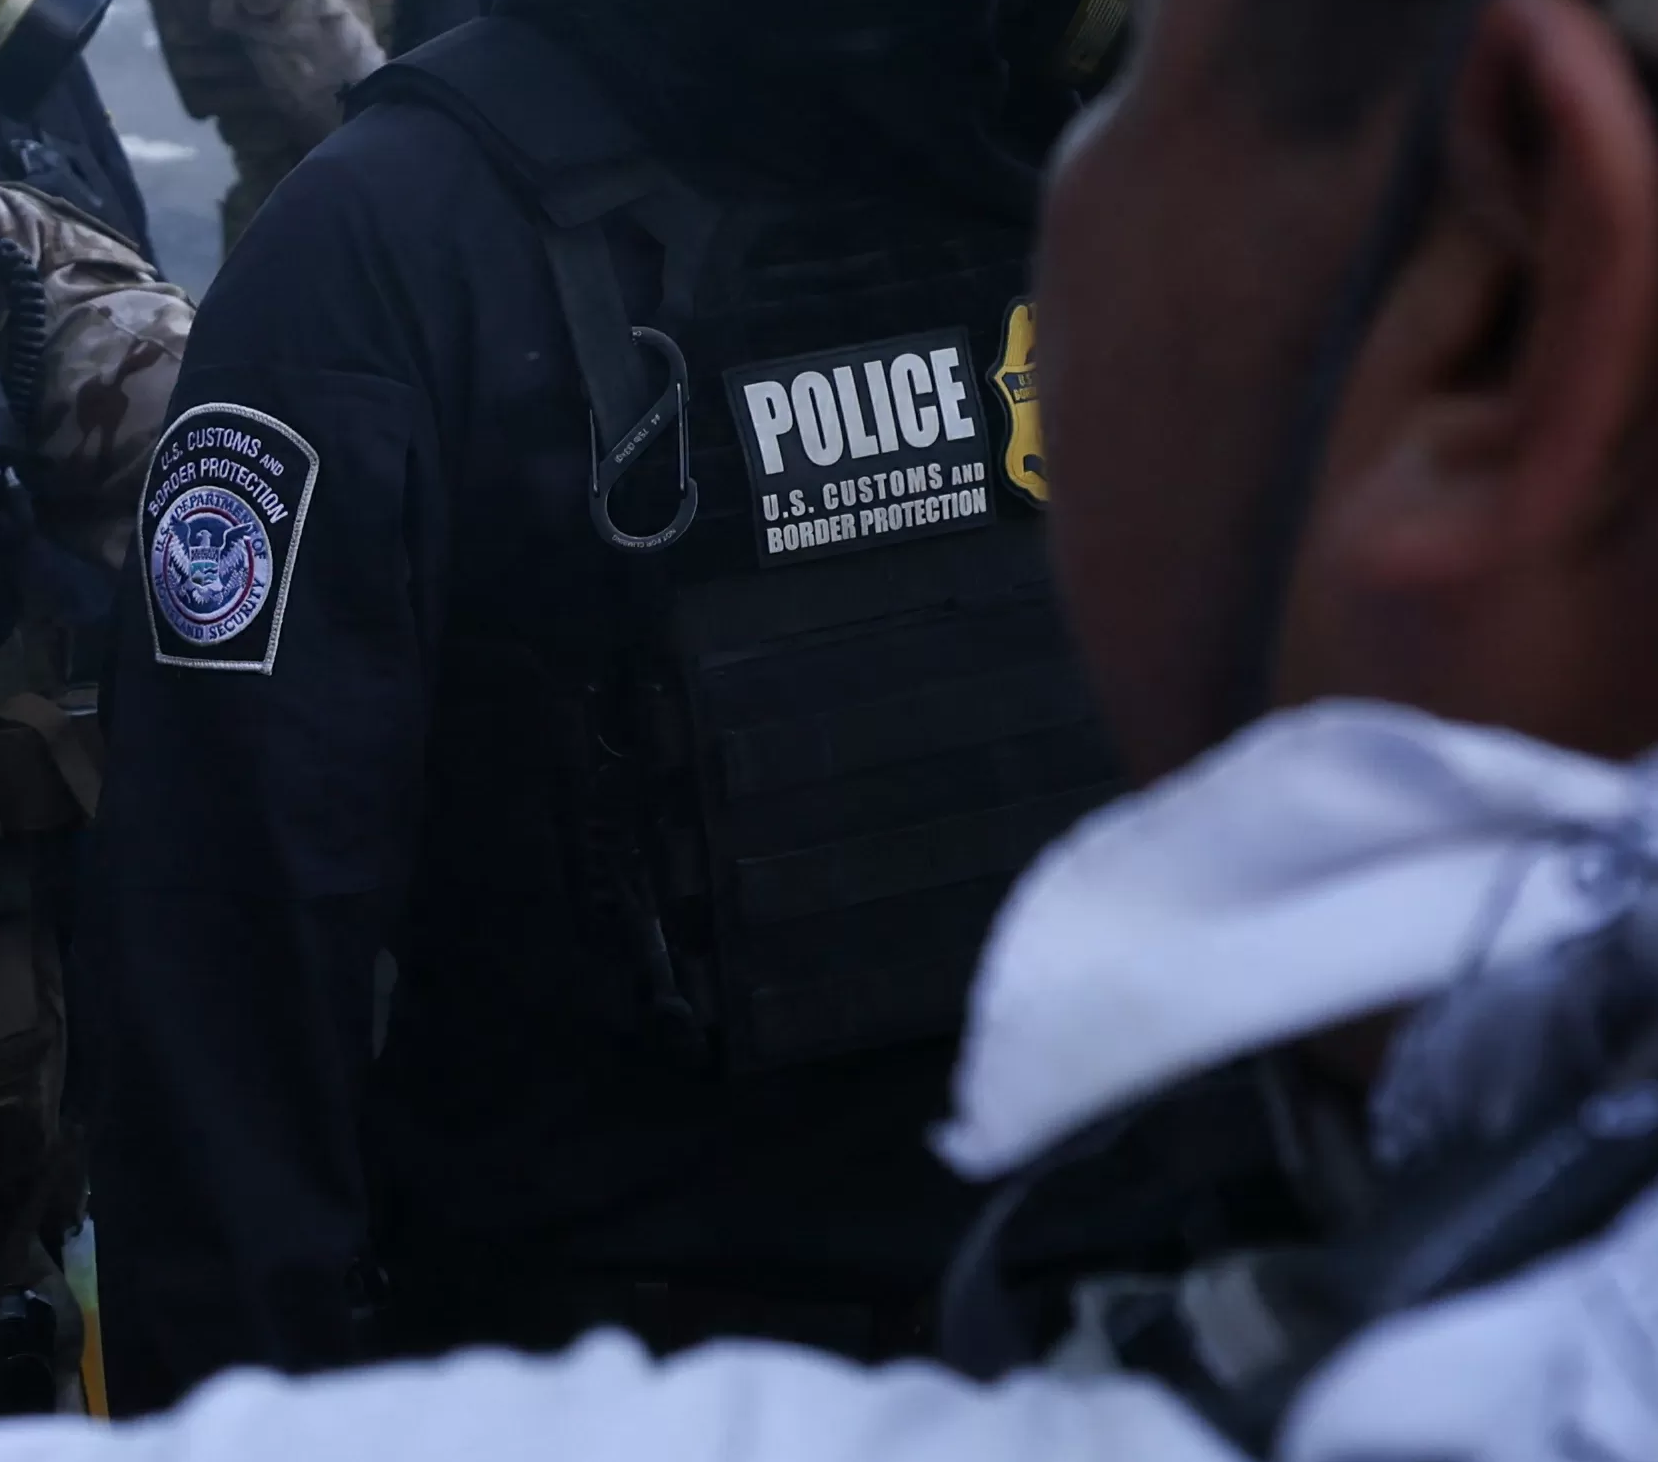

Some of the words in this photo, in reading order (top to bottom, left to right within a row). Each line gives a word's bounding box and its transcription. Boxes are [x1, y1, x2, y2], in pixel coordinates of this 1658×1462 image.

[743, 347, 976, 476] POLICE
[161, 442, 183, 470] U.S.
[187, 427, 262, 458] CUSTOMS
[259, 453, 284, 477] AND
[147, 461, 197, 518] BORDER
[201, 458, 289, 524] PROTECTION
[762, 490, 815, 522] U.S.
[822, 463, 943, 511] CUSTOMS
[951, 462, 985, 486] AND
[766, 513, 858, 555] BORDER
[860, 487, 987, 537] PROTECTION
[252, 538, 267, 560] OF
[209, 578, 266, 640] SECURITY
